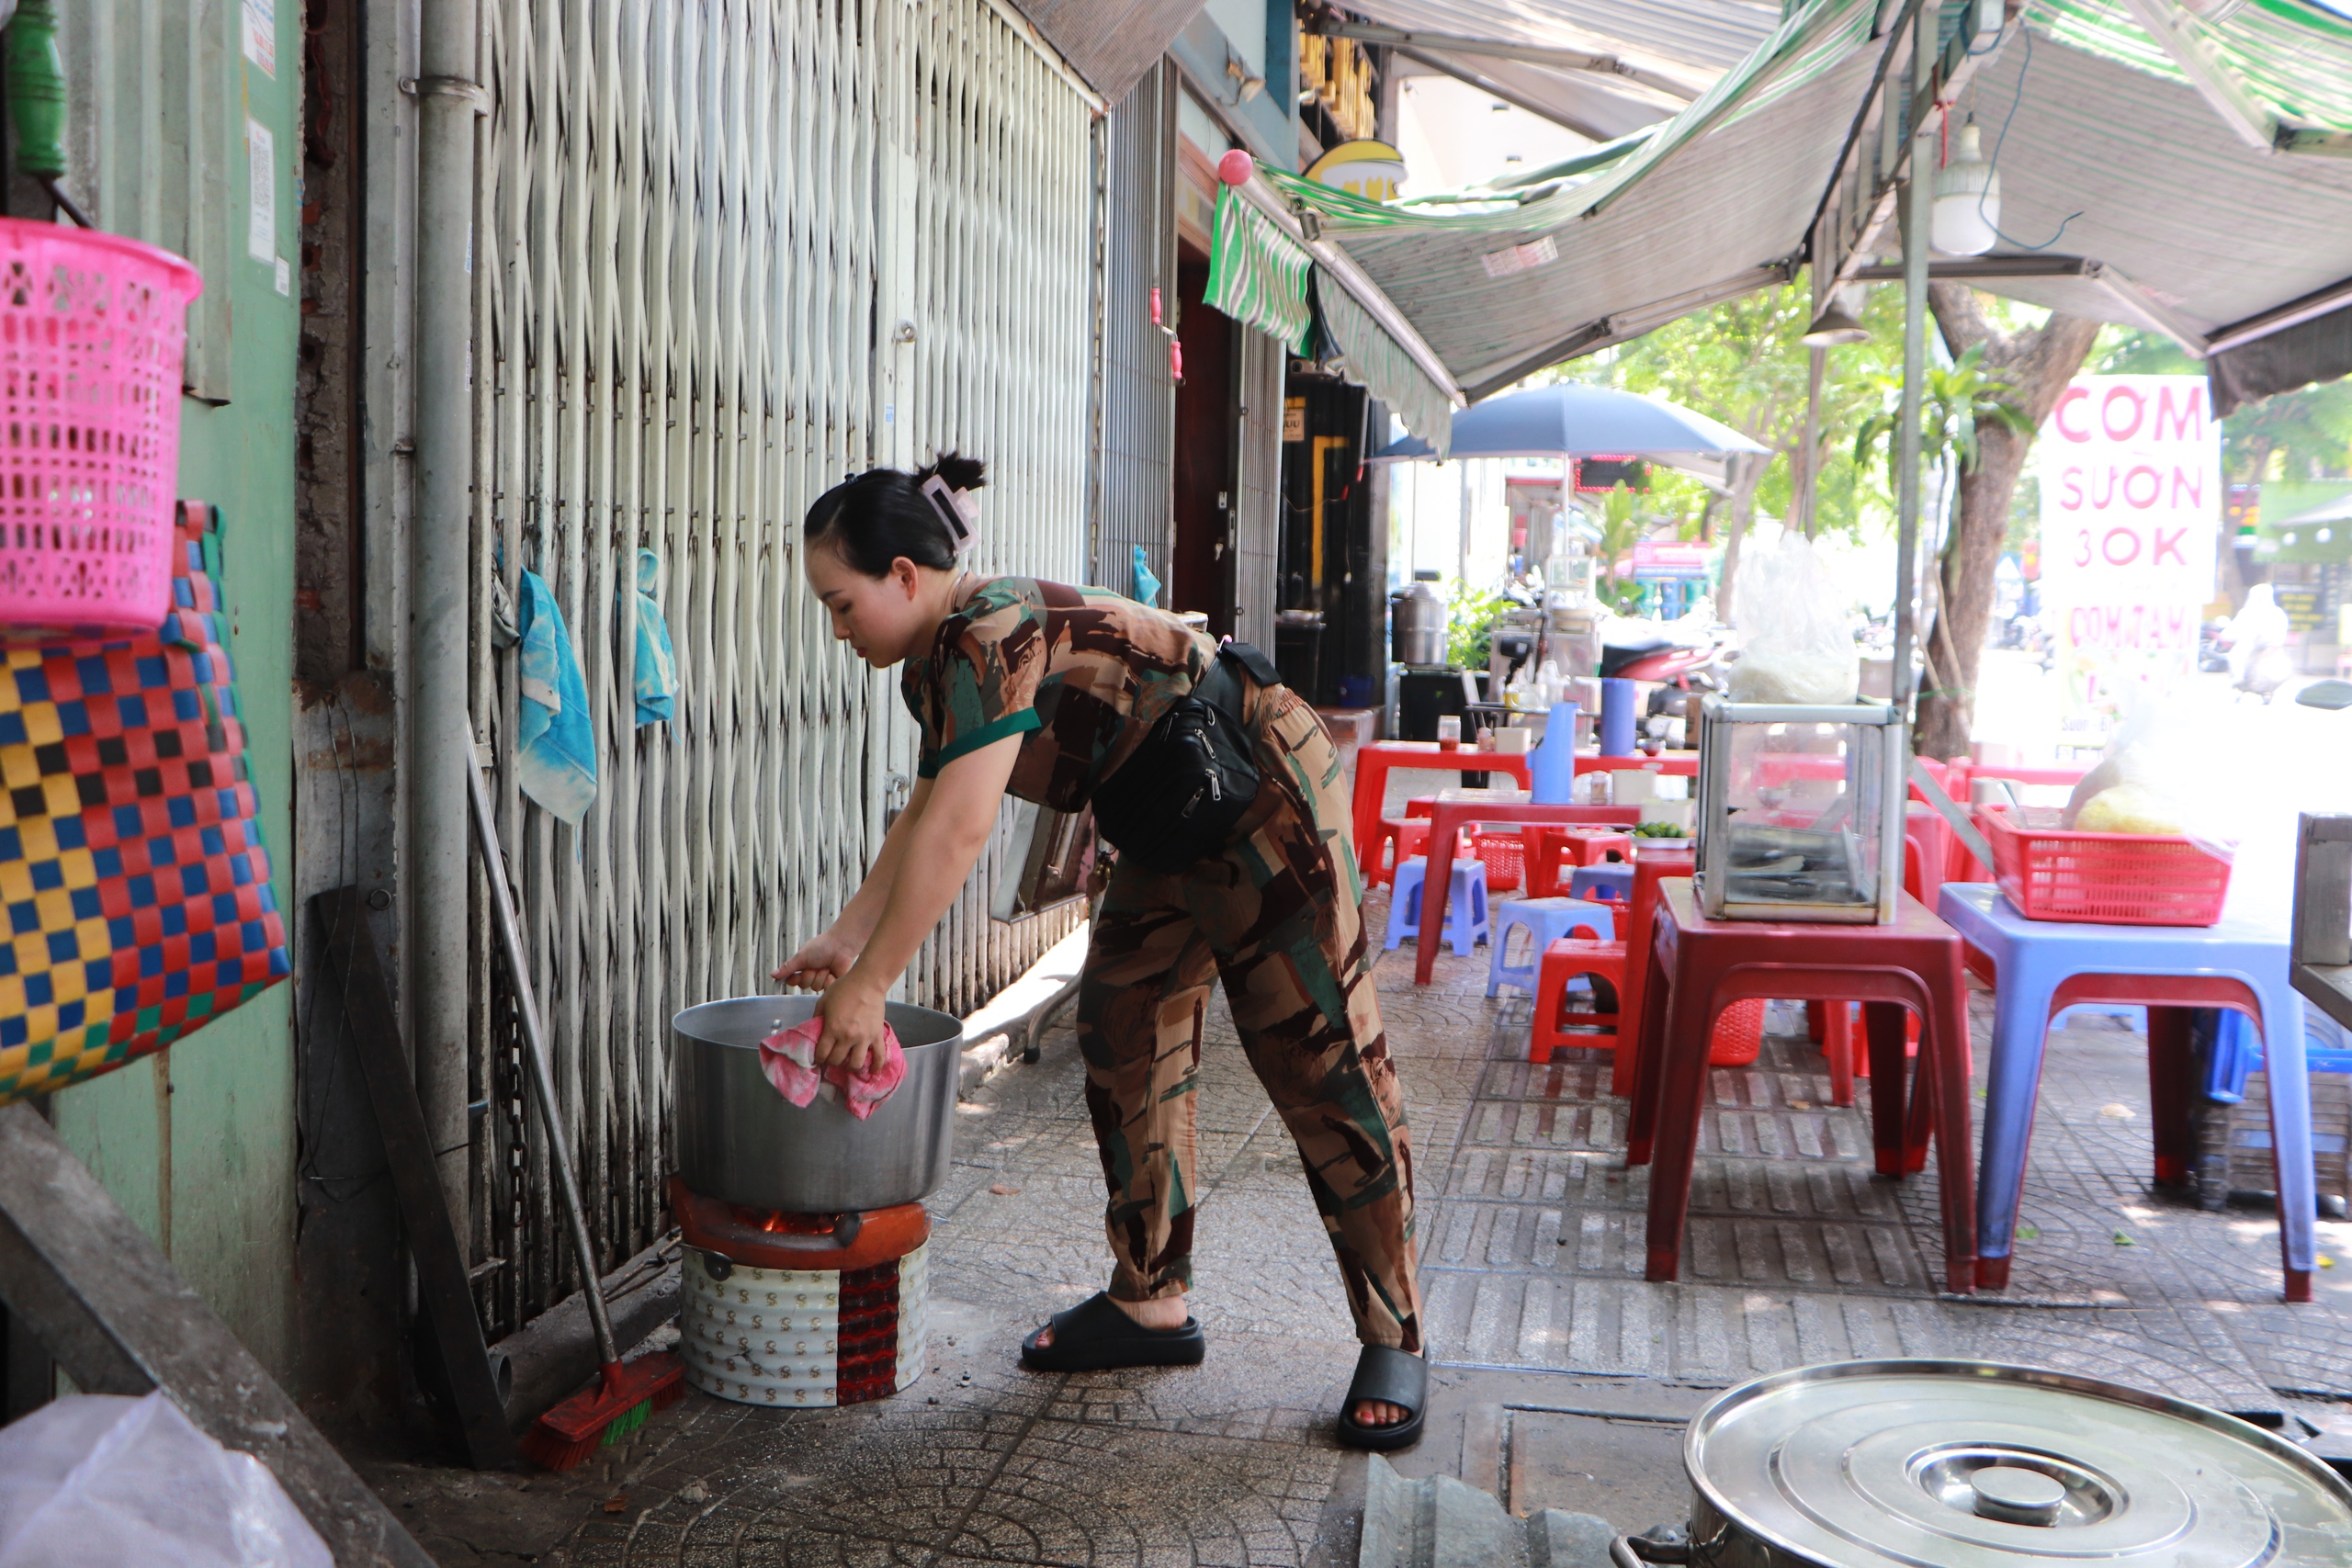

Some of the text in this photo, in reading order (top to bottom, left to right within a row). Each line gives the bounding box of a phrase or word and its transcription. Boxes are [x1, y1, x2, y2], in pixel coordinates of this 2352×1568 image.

[2054, 384, 2202, 444] CƠM
[2059, 451, 2202, 511] SƯỜN
[2075, 526, 2188, 568] 30K
